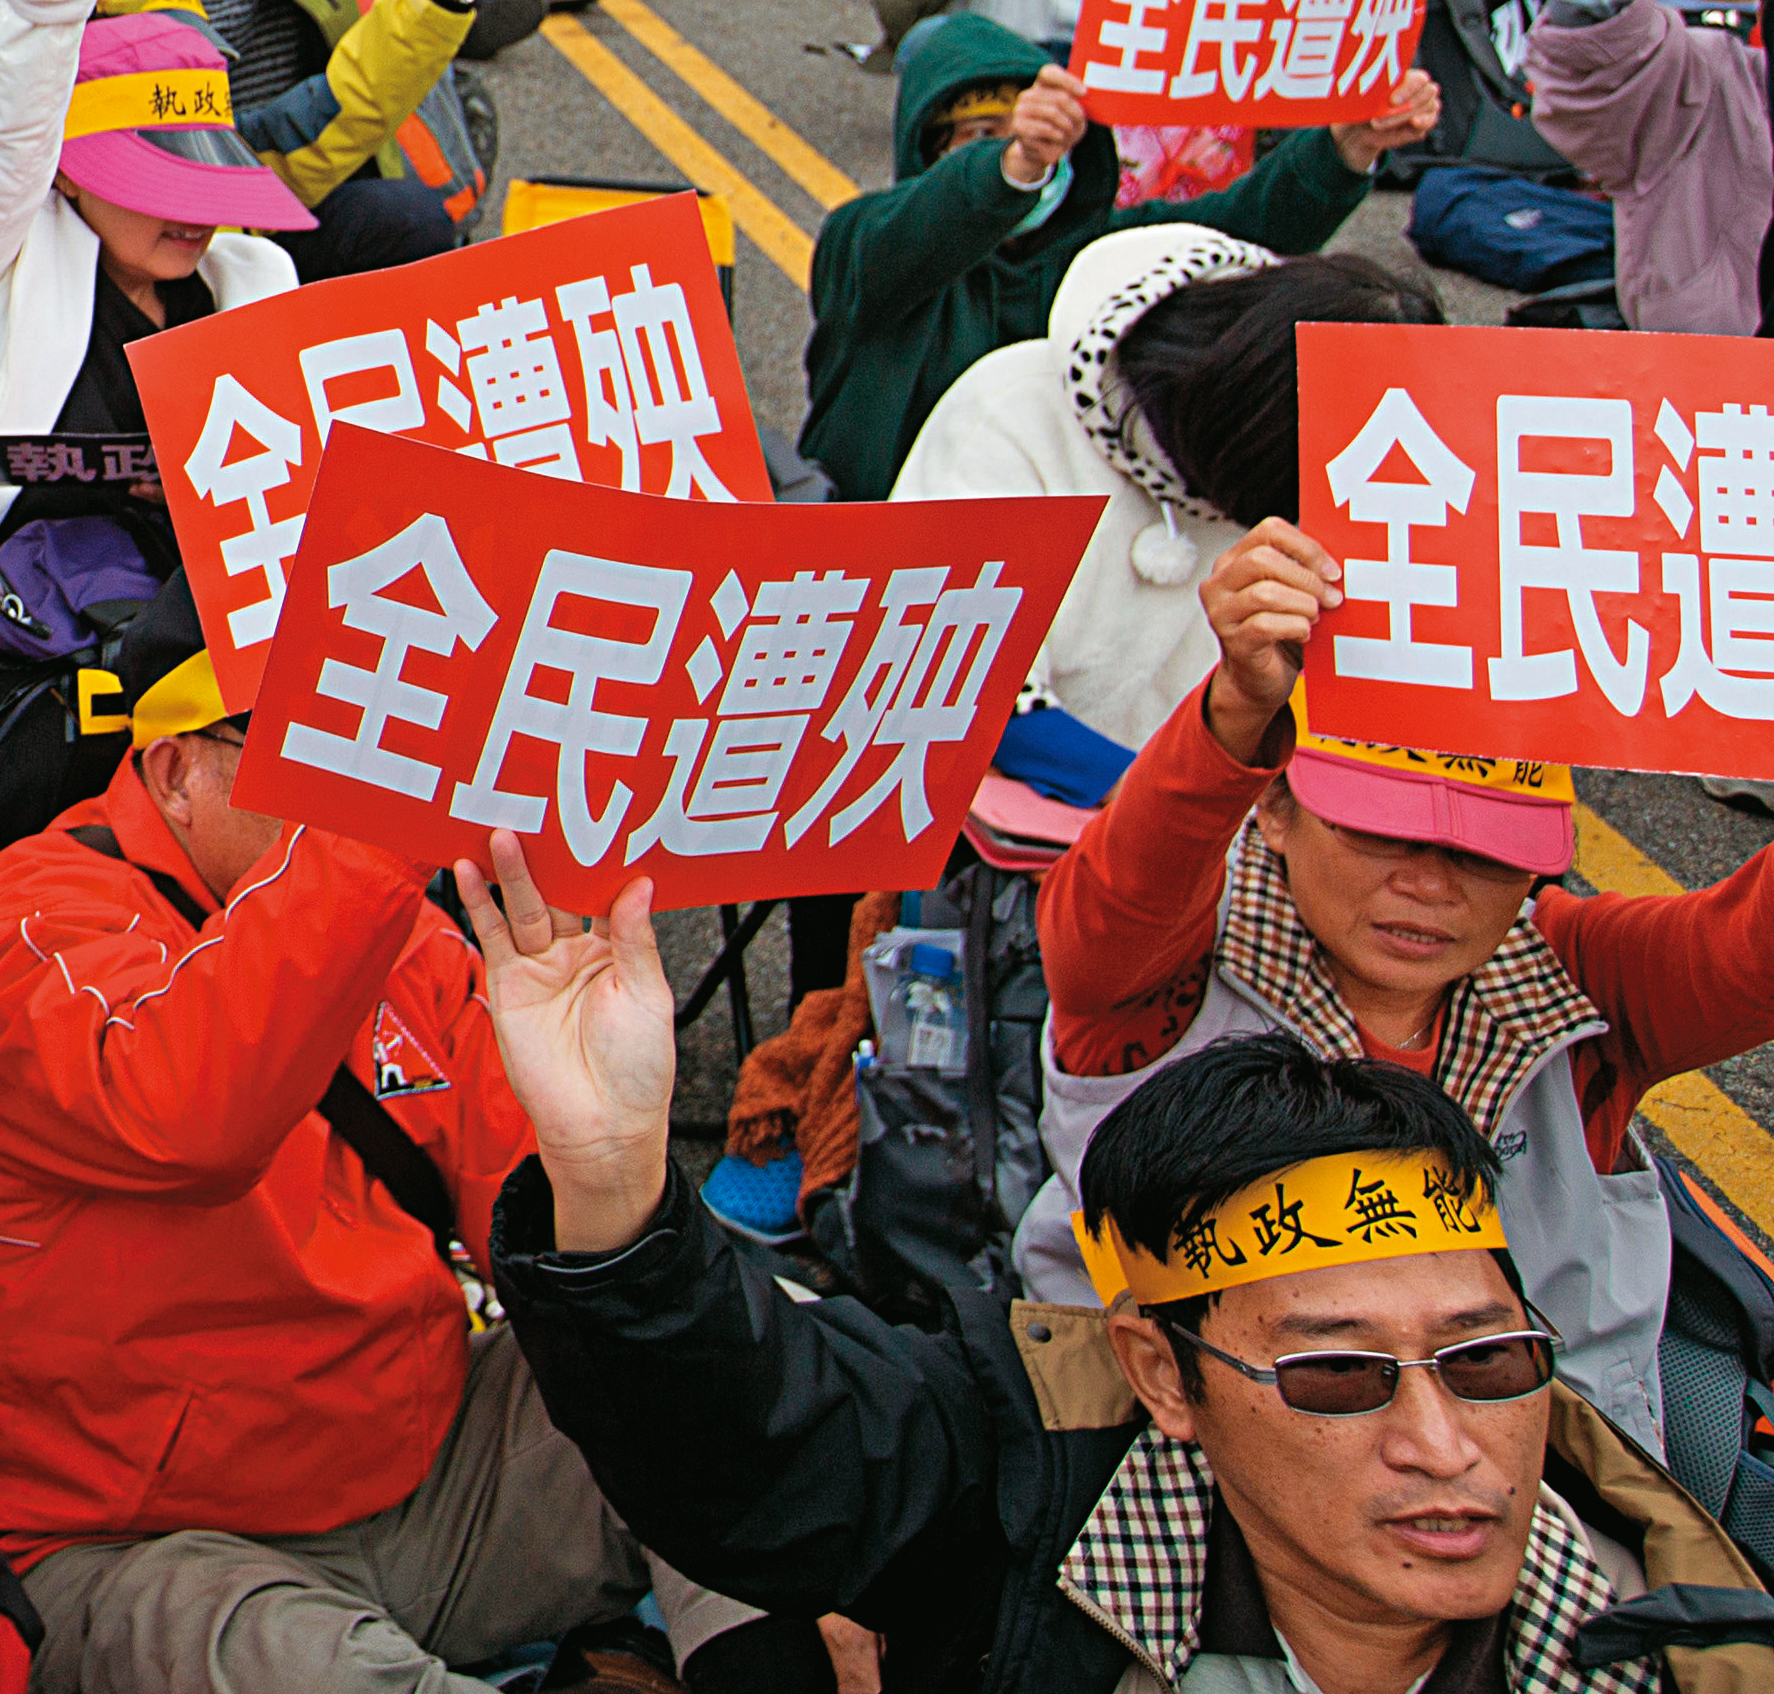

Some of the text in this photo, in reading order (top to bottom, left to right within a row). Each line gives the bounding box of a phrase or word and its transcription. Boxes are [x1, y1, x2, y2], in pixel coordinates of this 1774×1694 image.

[279, 512, 1024, 868] 全民遭殃
[1325, 386, 1774, 721] 全民遭
[1172, 1167, 1482, 1281] 執政無能
